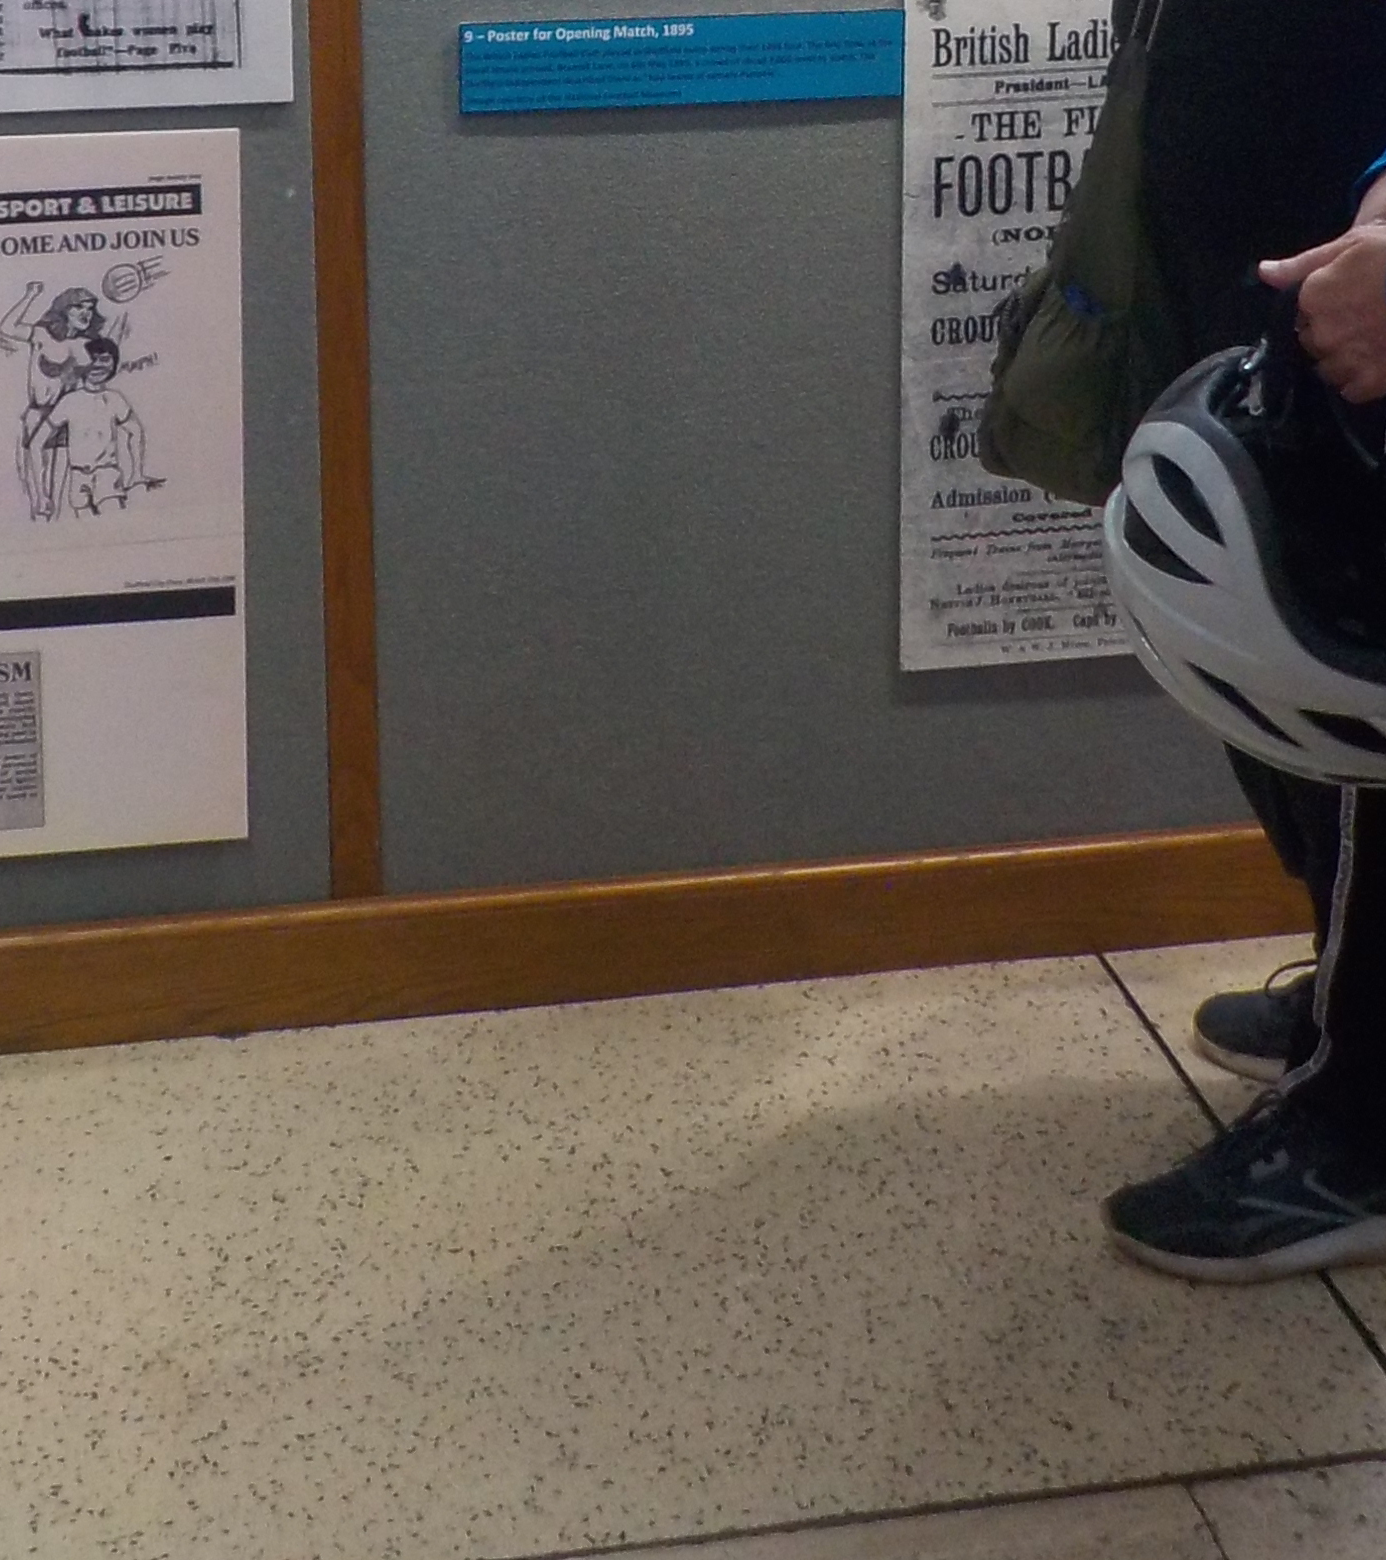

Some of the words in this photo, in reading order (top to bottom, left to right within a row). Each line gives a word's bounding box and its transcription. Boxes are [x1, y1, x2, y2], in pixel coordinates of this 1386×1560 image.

[463, 30, 474, 44] 9
[487, 28, 531, 44] Poster
[533, 27, 554, 42] for
[556, 26, 611, 44] Opening
[613, 23, 660, 41] Match,
[662, 22, 695, 39] 1895
[931, 22, 1030, 68] British
[971, 110, 1043, 143] THE
[933, 148, 1072, 219] FOOTB
[75, 196, 97, 216] &
[101, 191, 194, 214] LEISURE
[56, 232, 107, 253] AND
[110, 229, 167, 251] JOIN
[170, 228, 201, 248] US
[931, 485, 1032, 510] Admission
[1013, 507, 1093, 523] Covered
